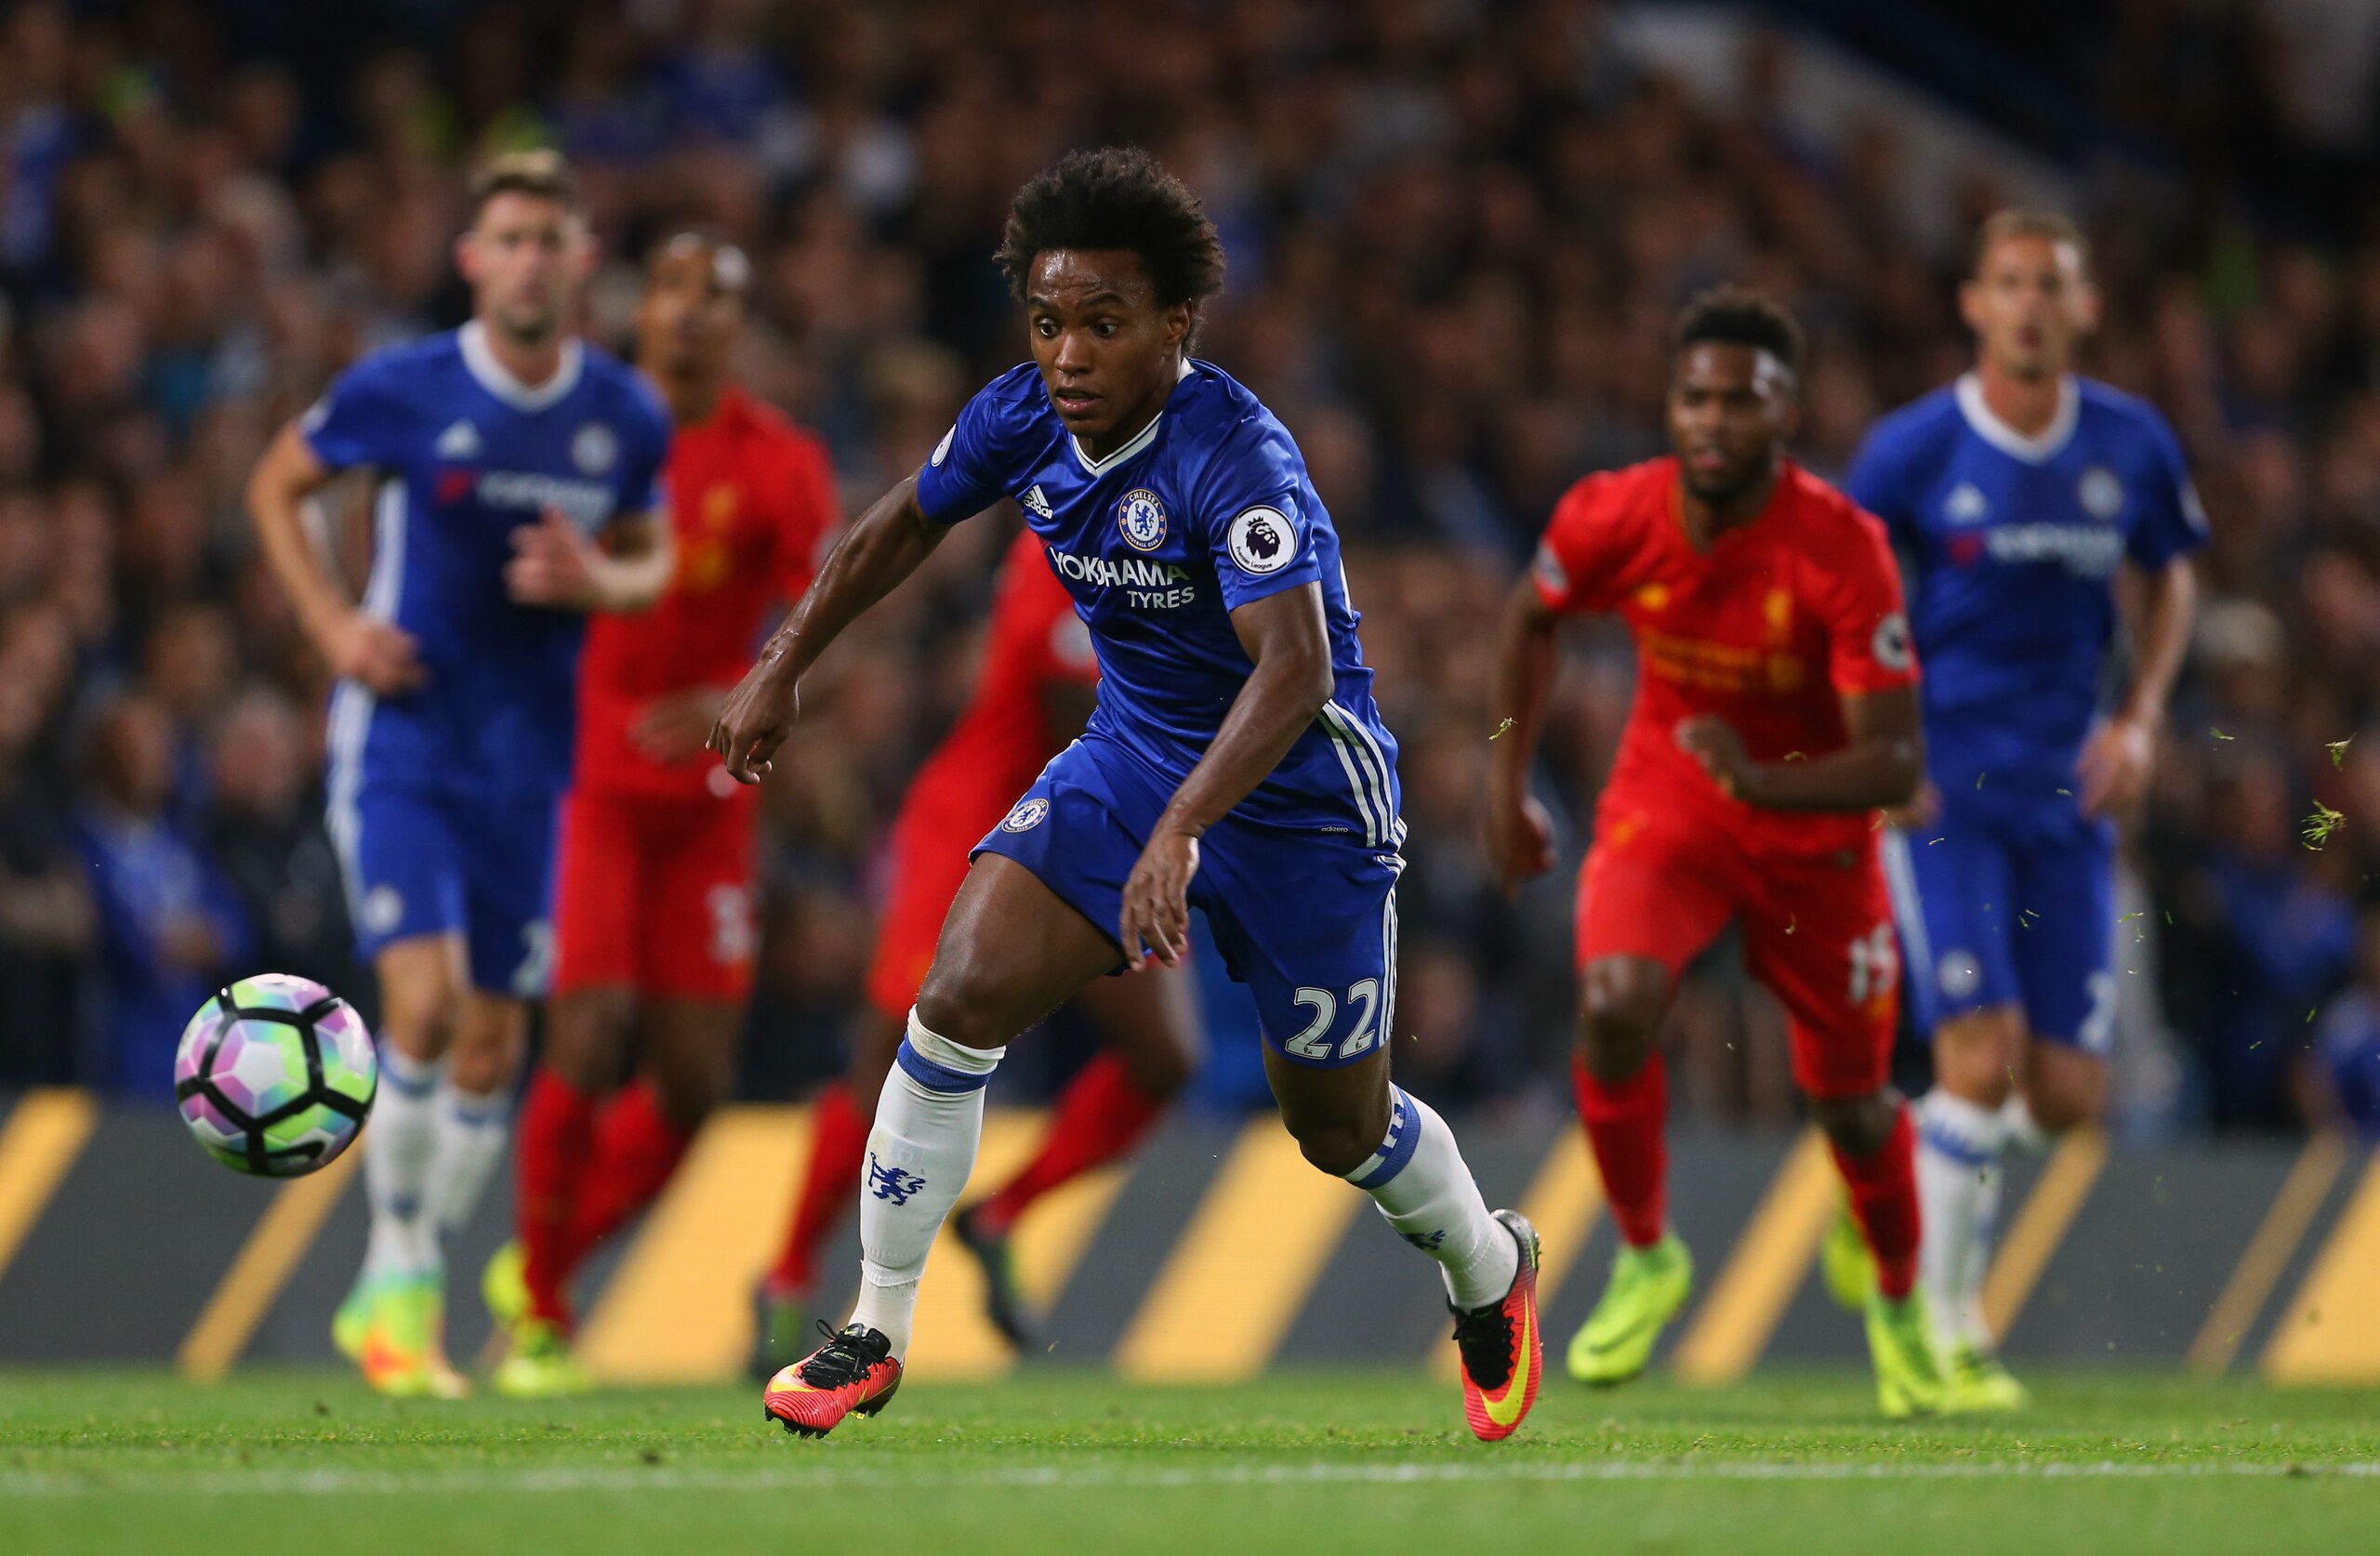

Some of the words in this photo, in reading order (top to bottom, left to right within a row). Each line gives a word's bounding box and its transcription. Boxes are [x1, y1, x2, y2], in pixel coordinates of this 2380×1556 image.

[1129, 491, 1159, 508] CHELSEA
[1024, 499, 1053, 520] adidas
[1126, 532, 1147, 547] FOOTBALL
[1147, 538, 1158, 547] CLUB
[1250, 561, 1273, 570] League
[1127, 587, 1195, 608] TYRES
[1285, 977, 1379, 1059] 22
